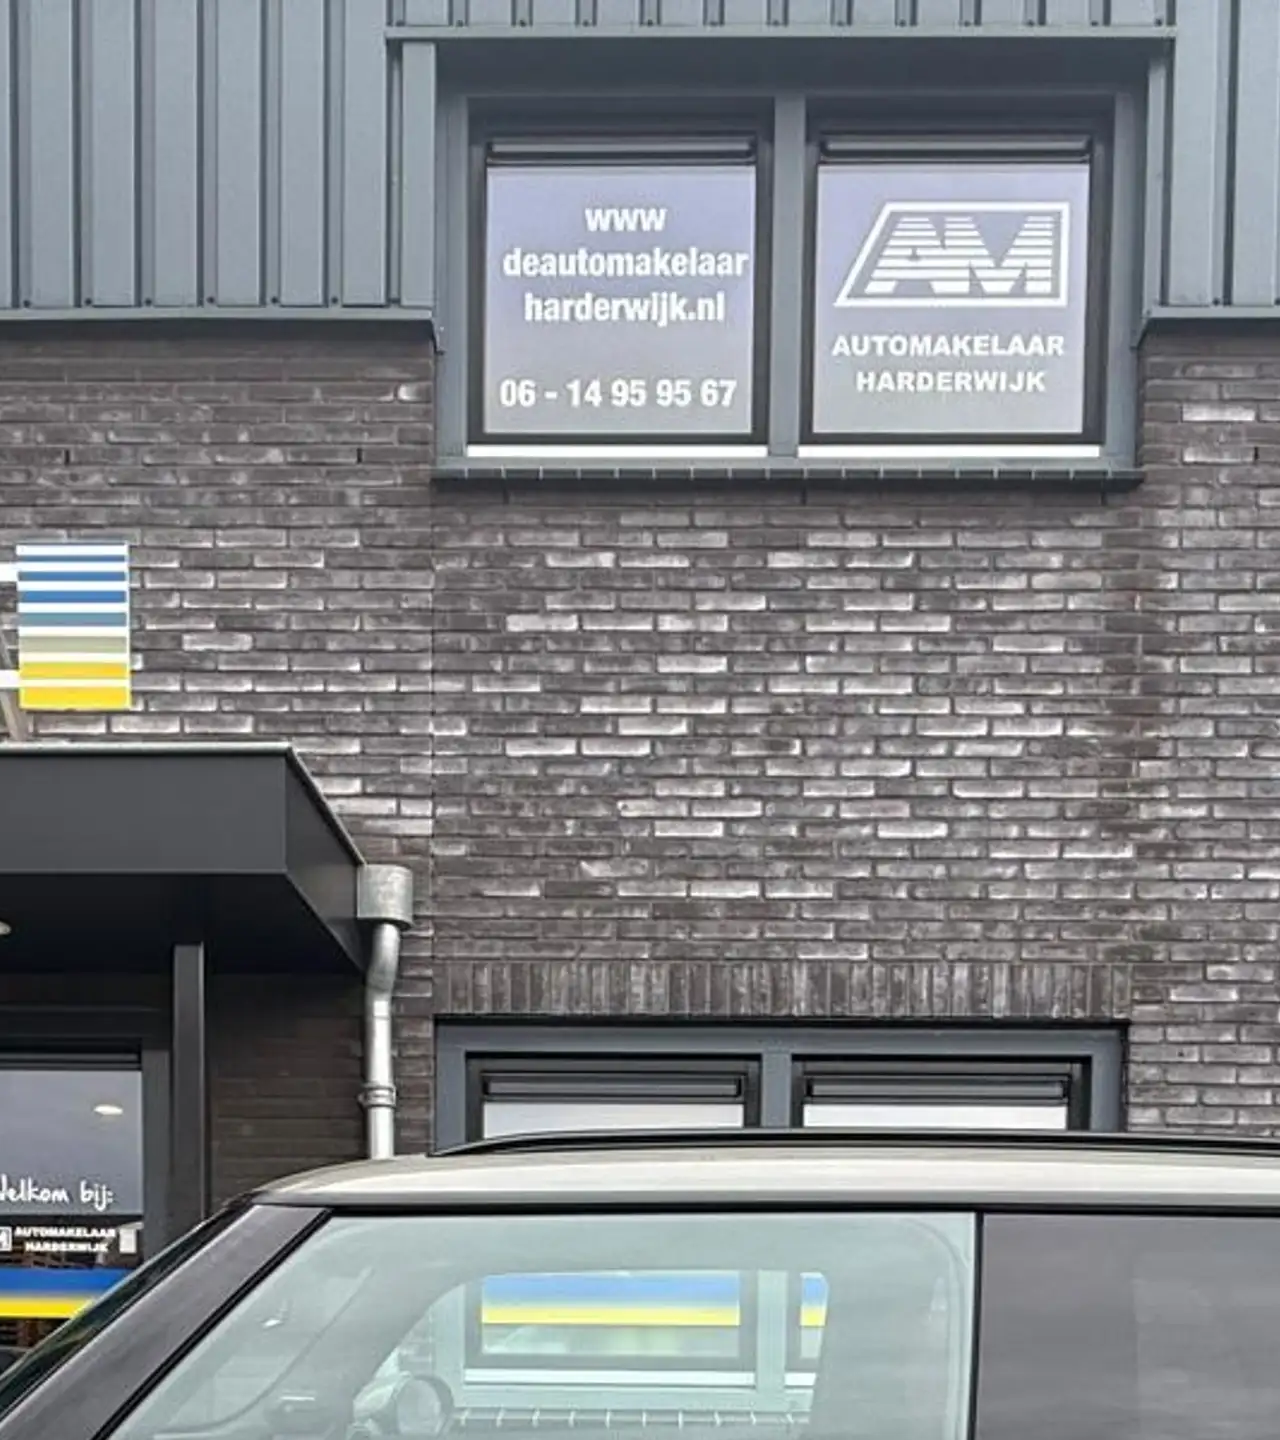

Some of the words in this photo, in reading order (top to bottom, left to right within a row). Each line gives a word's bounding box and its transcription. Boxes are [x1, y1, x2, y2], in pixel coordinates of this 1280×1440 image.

[584, 208, 667, 233] www
[502, 246, 750, 279] deautomakelaar
[863, 214, 1054, 295] AM
[523, 291, 726, 329] harderwijk.nl
[831, 334, 1066, 358] AUTOMAKELAAR
[499, 378, 537, 408] 06
[567, 378, 604, 408] 14
[610, 378, 648, 408] 95
[655, 378, 693, 408] 95
[699, 378, 738, 408] 67
[856, 369, 1047, 394] HARDERWIJK
[80, 1180, 114, 1212] bij:
